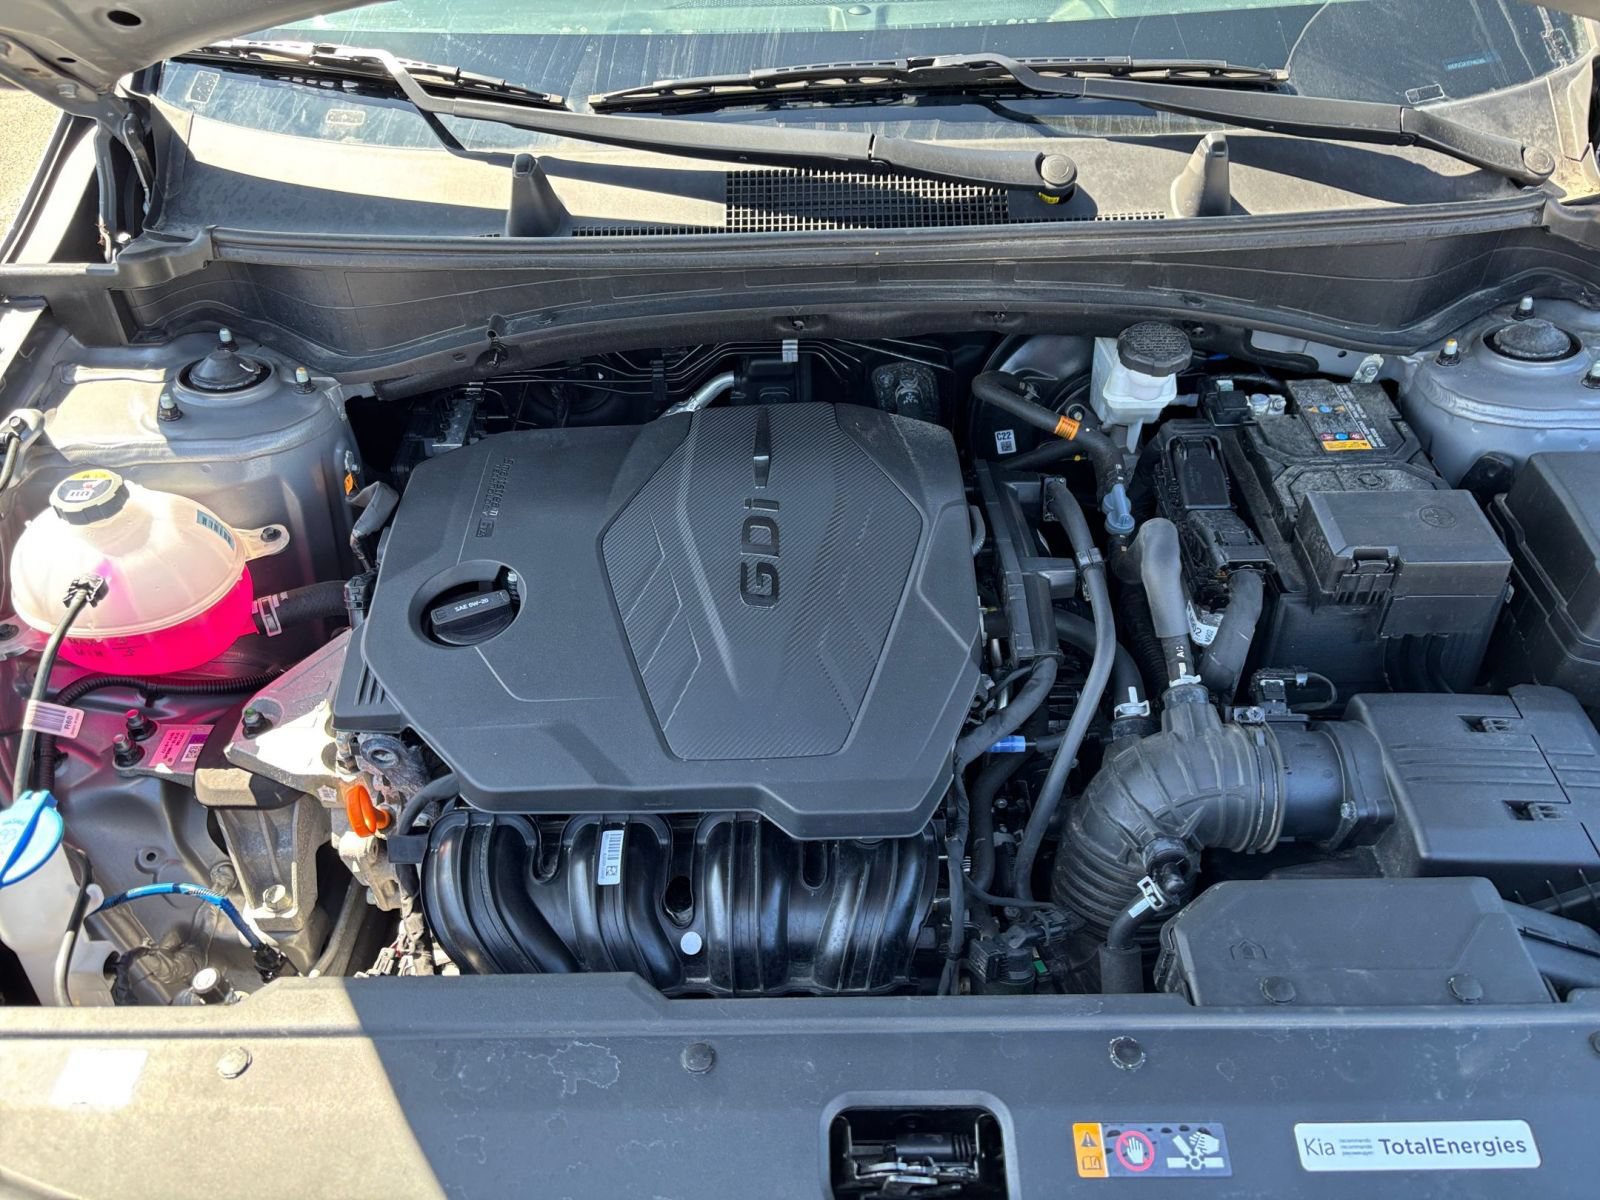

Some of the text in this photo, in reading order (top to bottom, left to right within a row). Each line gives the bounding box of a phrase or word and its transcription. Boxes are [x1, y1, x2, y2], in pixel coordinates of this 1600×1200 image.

[996, 431, 1012, 441] C22
[740, 497, 780, 608] GDi
[454, 598, 489, 612] SAE 0W-20
[1303, 1136, 1527, 1157] Kia TotalEnergies
